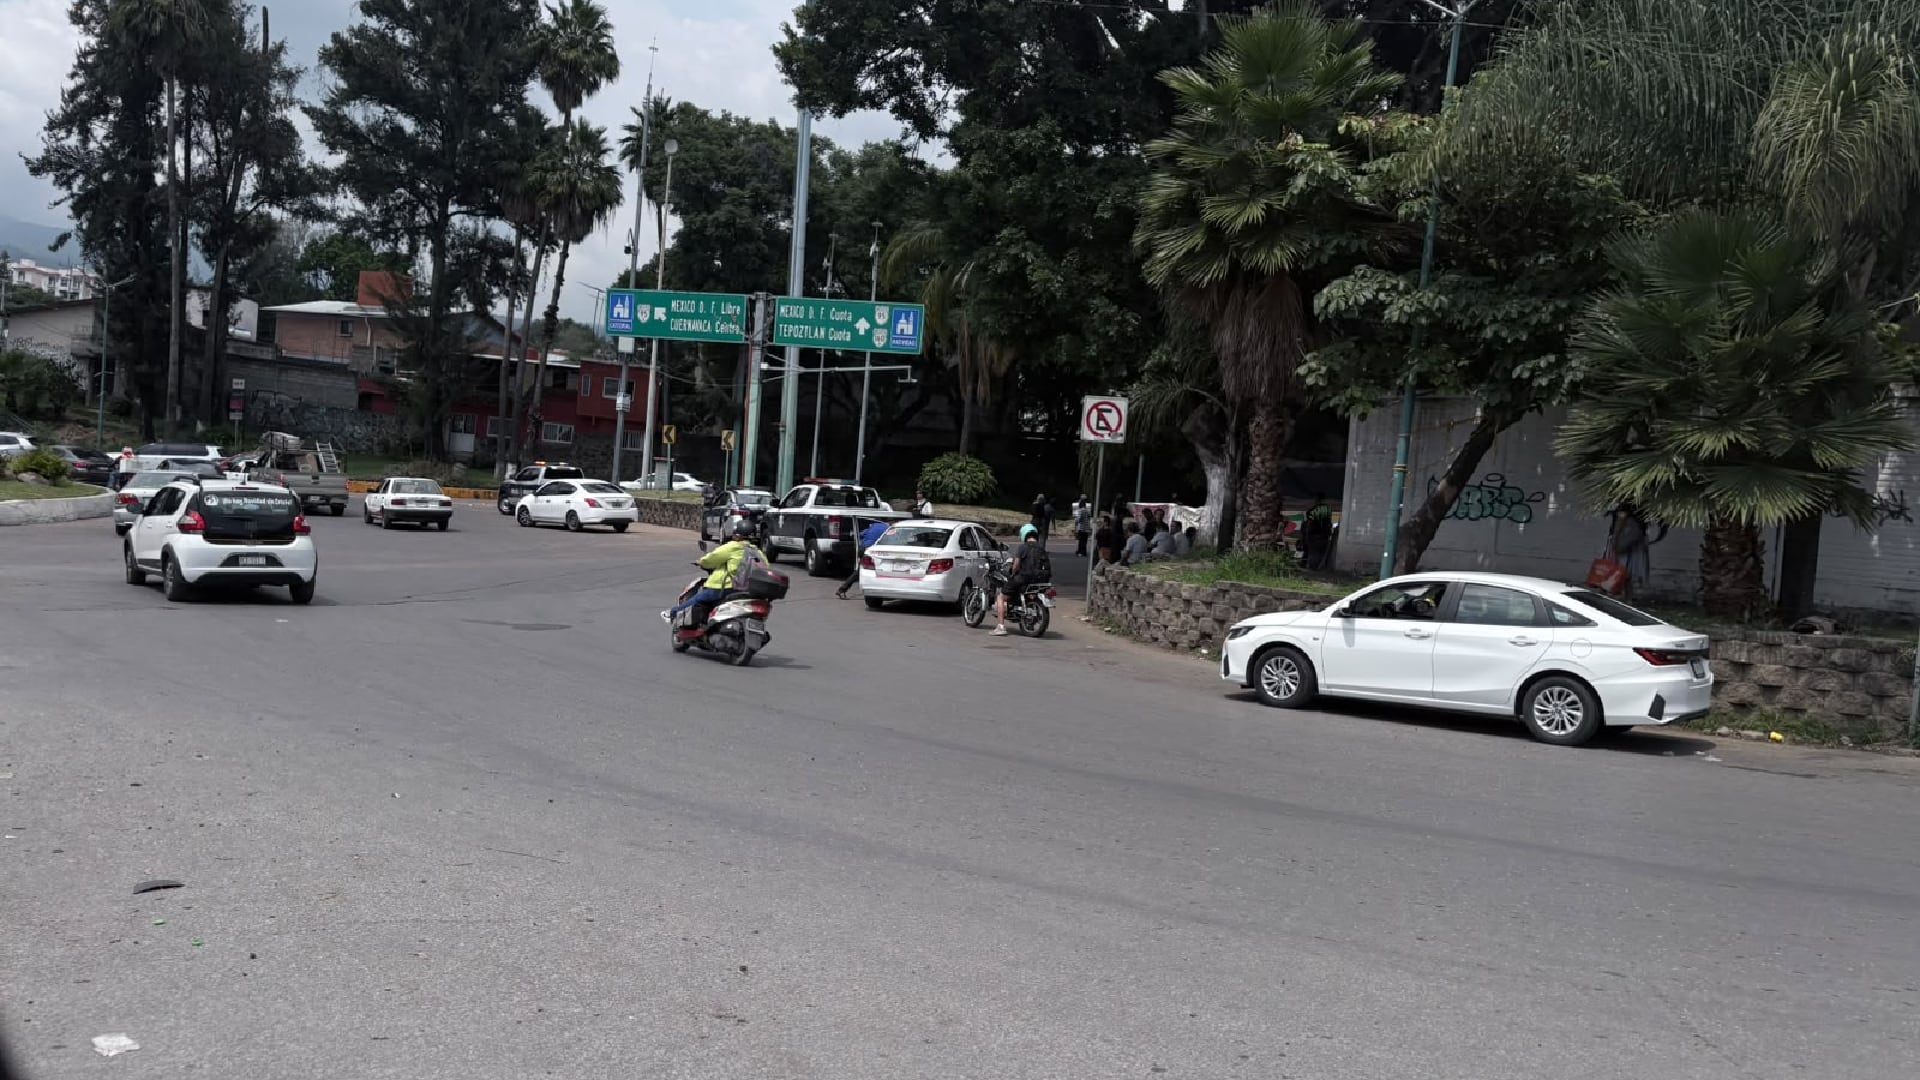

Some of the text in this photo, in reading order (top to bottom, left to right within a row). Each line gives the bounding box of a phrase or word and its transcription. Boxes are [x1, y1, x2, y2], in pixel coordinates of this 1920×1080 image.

[721, 301, 740, 315] Libre
[829, 307, 852, 323] Cuota
[779, 324, 851, 342] TEPOZTLAN Cuota
